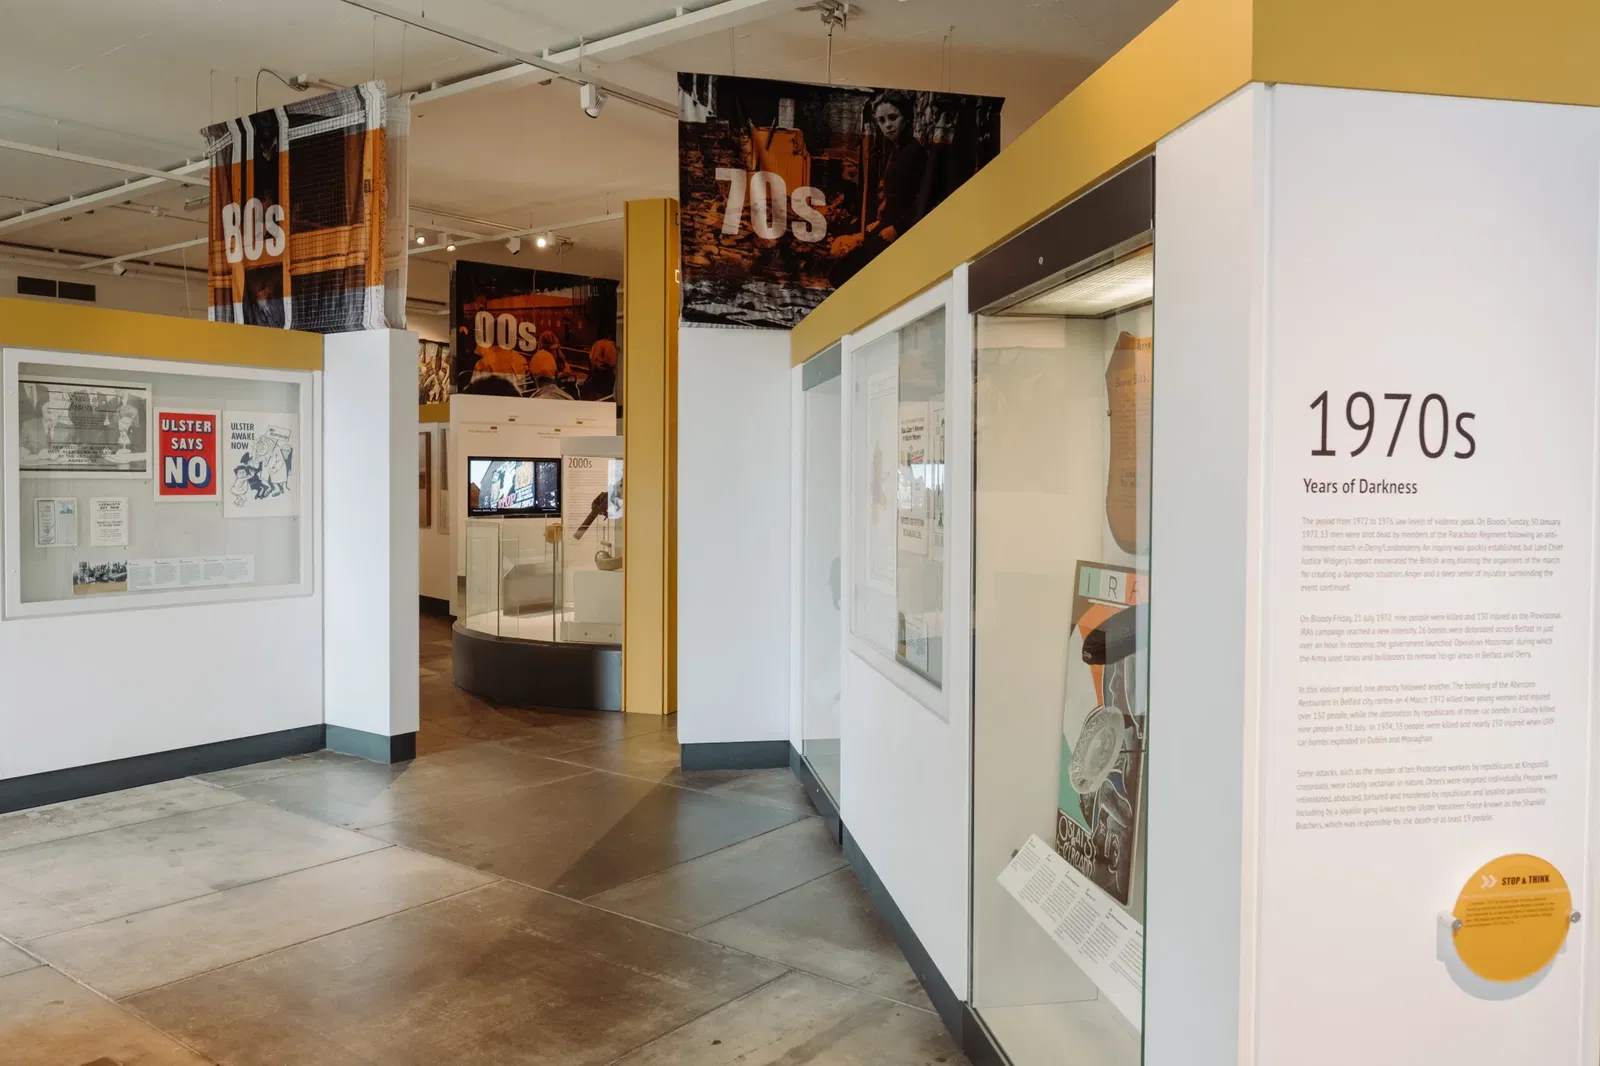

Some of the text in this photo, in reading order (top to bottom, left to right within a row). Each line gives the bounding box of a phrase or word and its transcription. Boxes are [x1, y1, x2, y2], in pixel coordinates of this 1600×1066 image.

[715, 168, 827, 242] 70s
[222, 198, 285, 263] 80s
[474, 311, 537, 352] 00s
[162, 419, 212, 433] ULSTER
[231, 423, 254, 431] ULSTER
[1310, 390, 1476, 459] 1970s
[171, 438, 204, 450] SAYS
[231, 433, 255, 441] AWAKE
[231, 442, 249, 450] NOW
[568, 458, 592, 468] 2000s
[165, 456, 210, 486] NO
[1304, 478, 1418, 494] Years of Darkness
[1502, 877, 1520, 886] STOP
[1529, 875, 1550, 884] THINK
